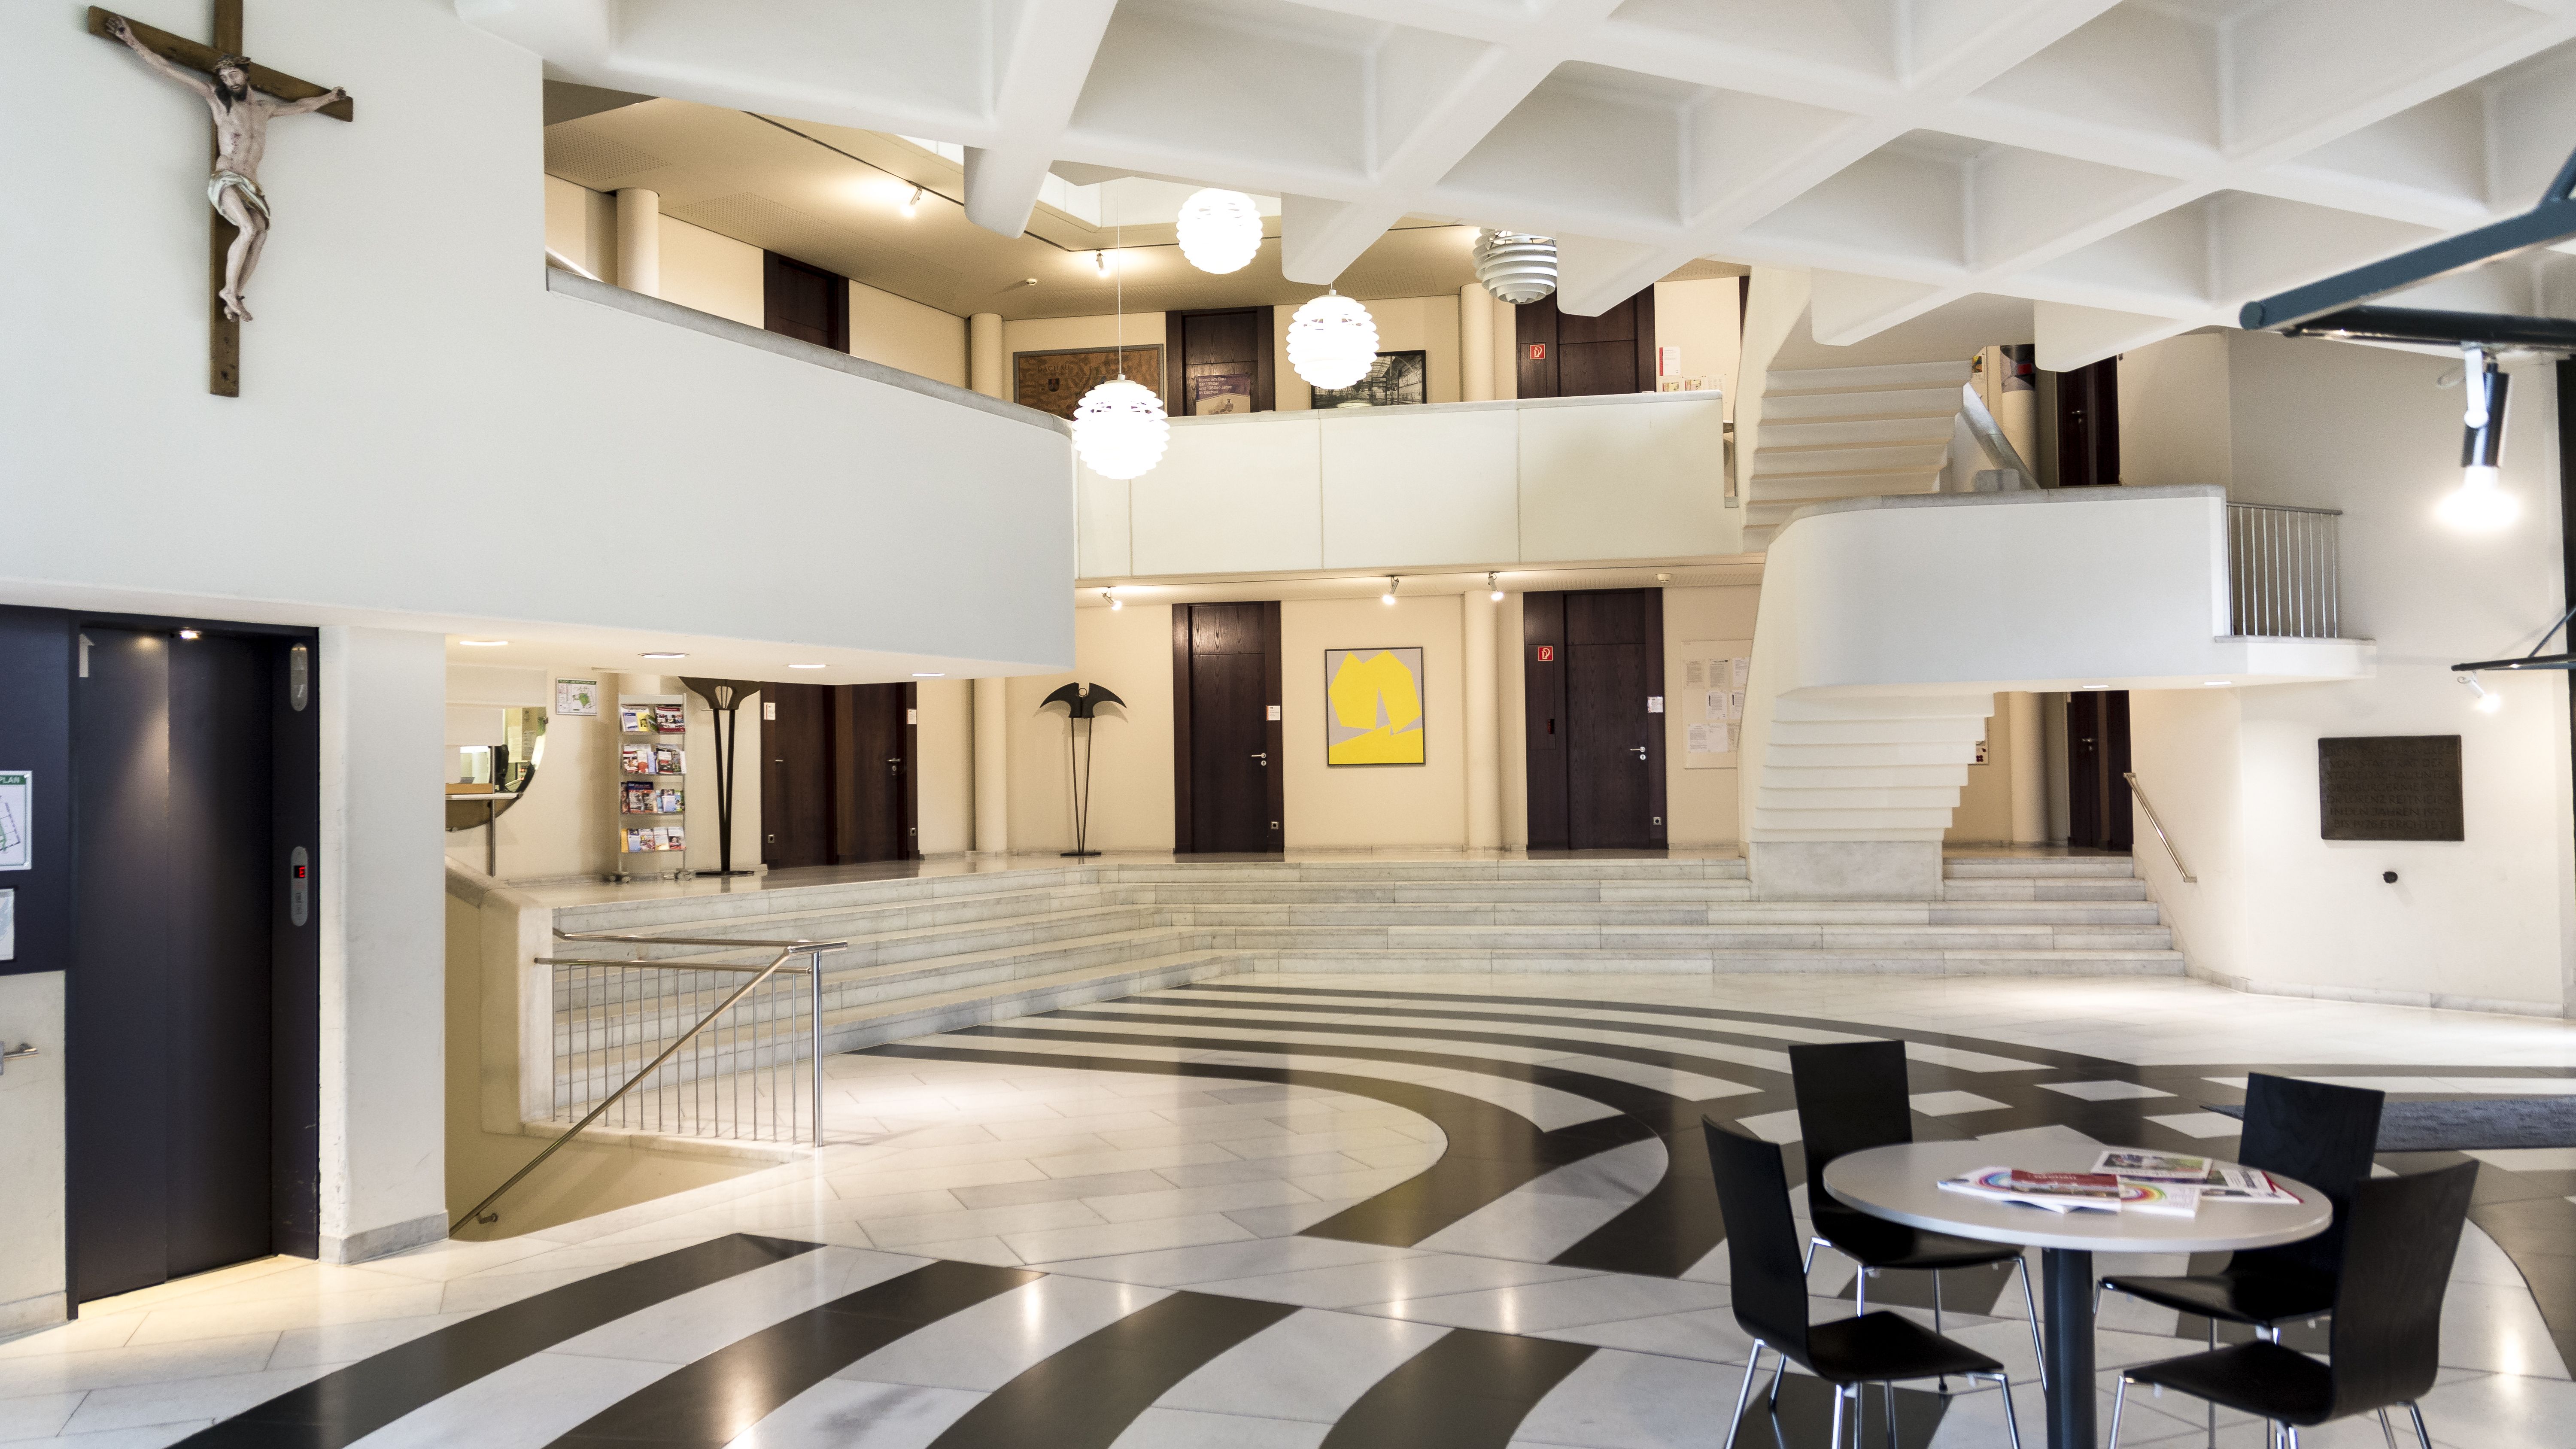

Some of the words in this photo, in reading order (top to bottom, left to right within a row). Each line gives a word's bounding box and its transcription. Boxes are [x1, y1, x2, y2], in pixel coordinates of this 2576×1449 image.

[2329, 759, 2355, 769] VOM
[2422, 758, 2445, 768] DER
[2325, 771, 2364, 780] STADT
[2365, 771, 2413, 780] DACHAU
[2415, 771, 2452, 780] UNTER
[2344, 795, 2386, 805] LORENZ
[2388, 795, 2452, 805] REITMEIER
[2330, 808, 2343, 816] IN
[2345, 807, 2369, 816] DEN
[2371, 807, 2420, 816] JAHREN
[2334, 819, 2351, 829] BIS
[299, 867, 306, 877] E
